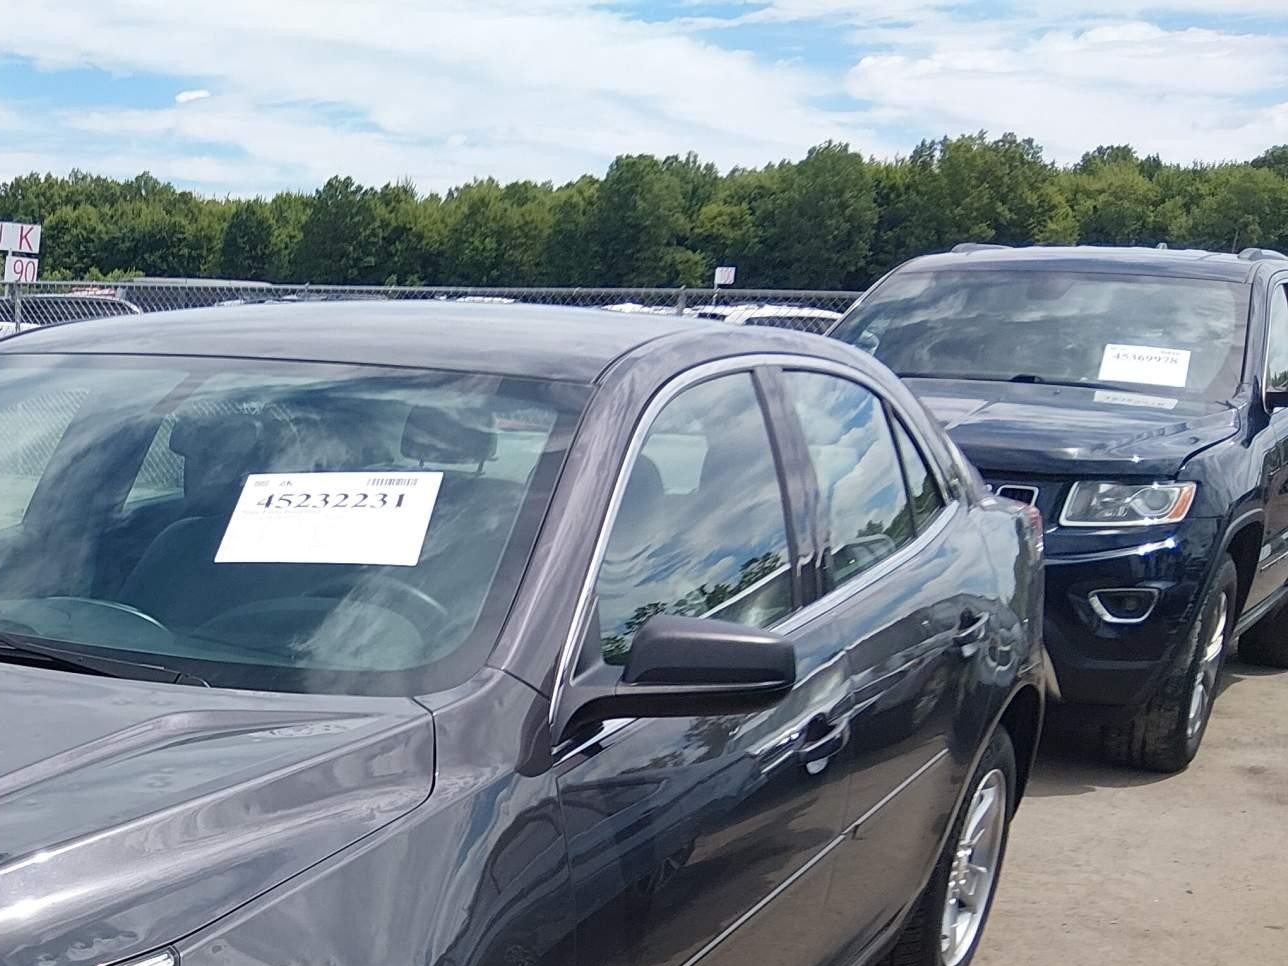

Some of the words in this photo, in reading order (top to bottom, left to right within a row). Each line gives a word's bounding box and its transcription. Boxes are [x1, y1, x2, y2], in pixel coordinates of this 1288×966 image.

[19, 225, 34, 251] K
[13, 259, 36, 283] 90
[256, 493, 405, 509] 45232231
